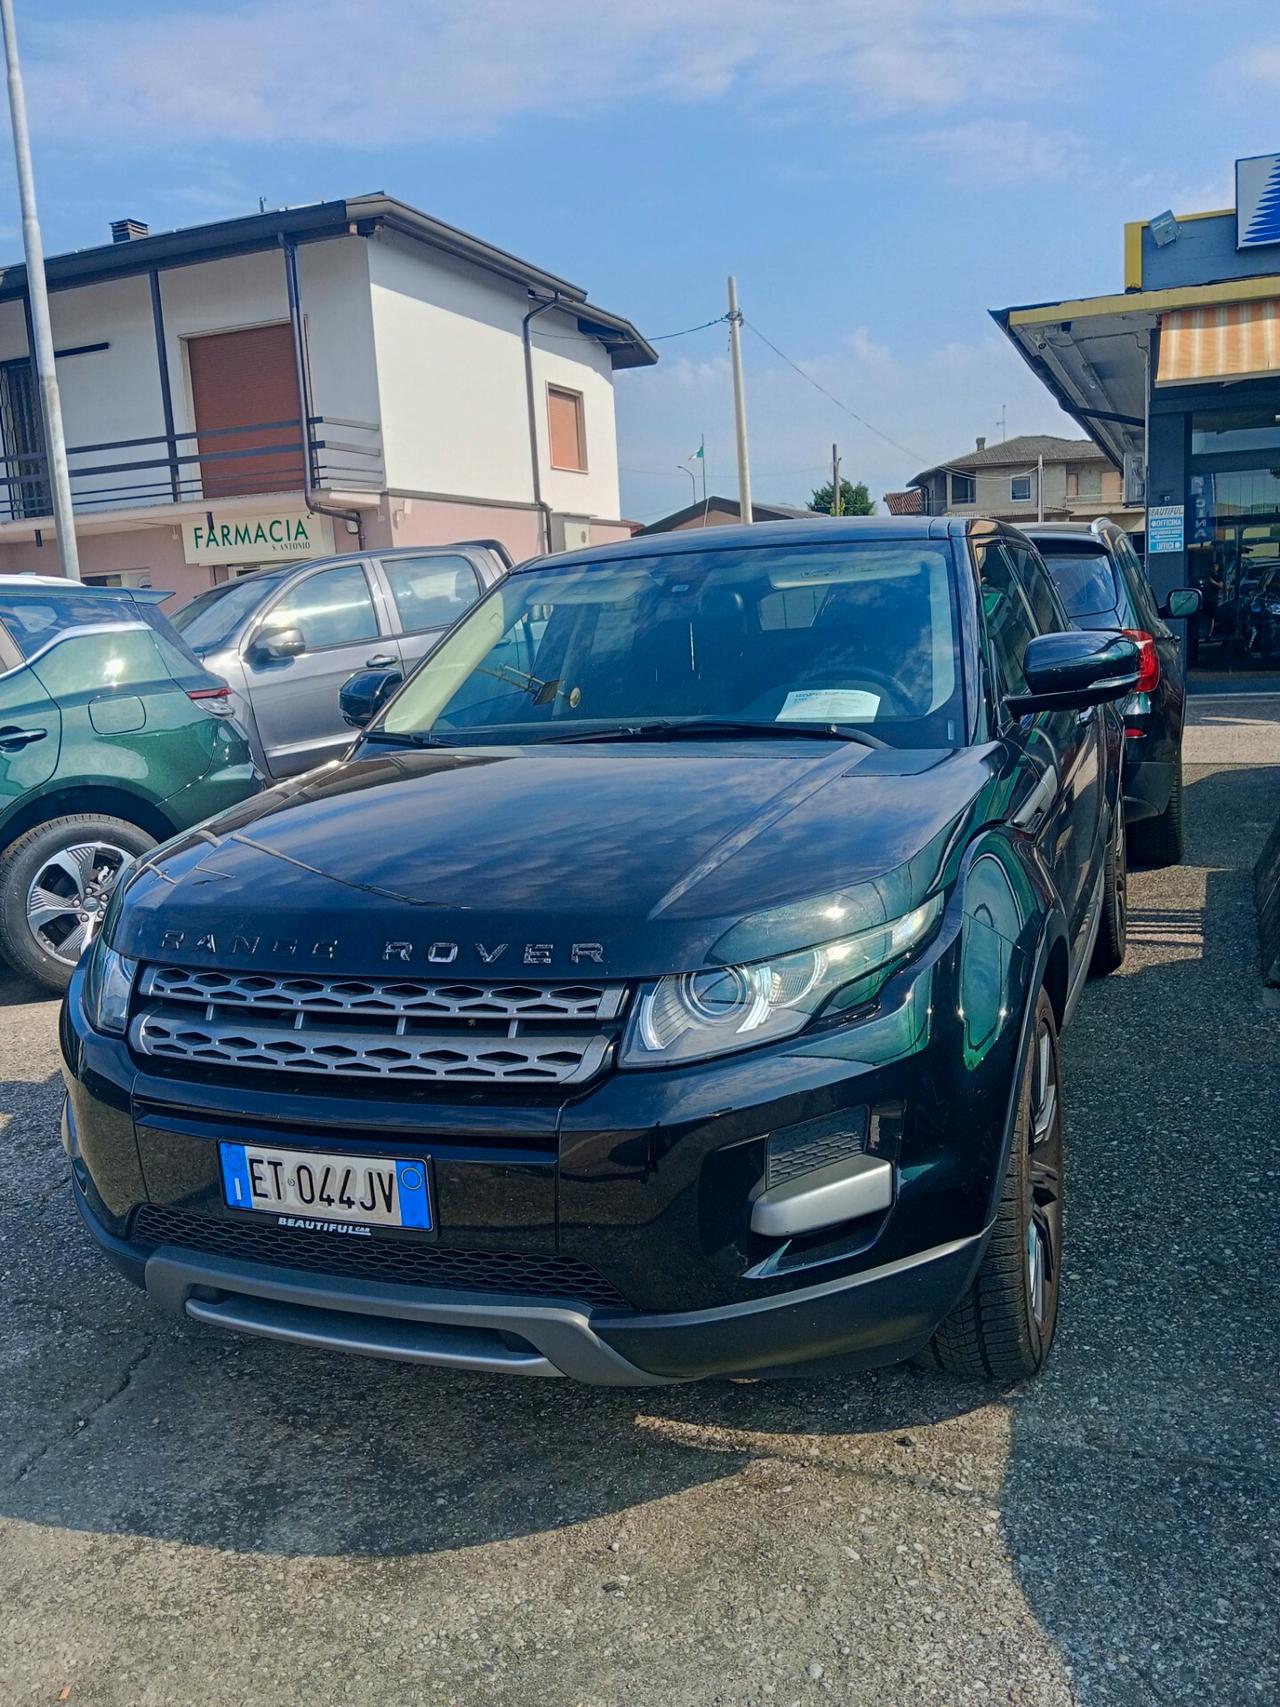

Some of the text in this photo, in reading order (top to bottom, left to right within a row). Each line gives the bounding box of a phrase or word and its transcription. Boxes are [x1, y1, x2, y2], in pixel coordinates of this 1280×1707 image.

[194, 518, 309, 549] FARMACIA
[280, 542, 311, 552] ANTONIO
[160, 930, 606, 965] RANGE ROVER
